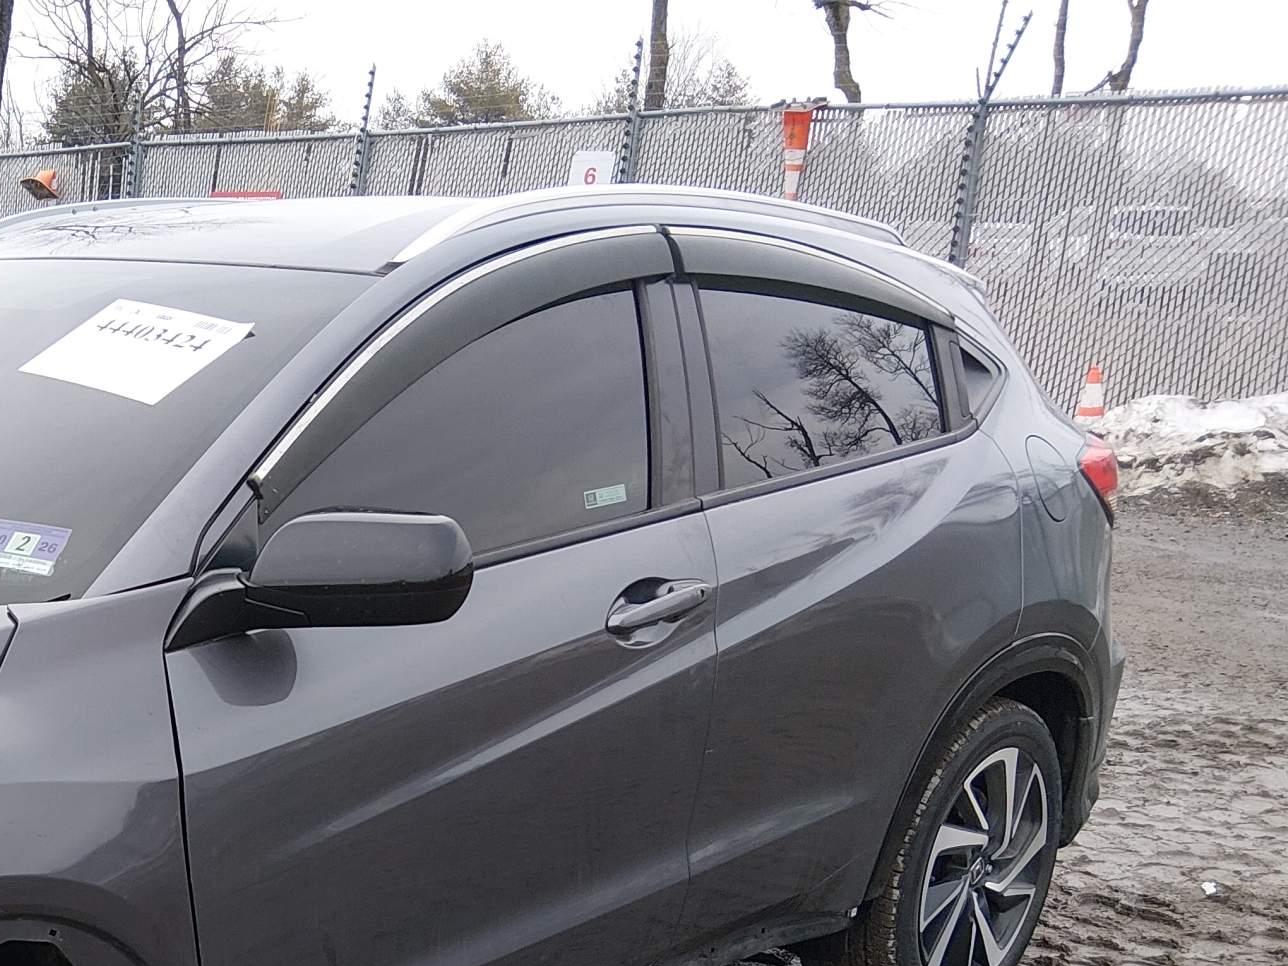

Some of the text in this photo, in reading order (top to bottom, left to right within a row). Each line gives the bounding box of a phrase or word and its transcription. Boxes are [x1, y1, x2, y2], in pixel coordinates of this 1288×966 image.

[584, 168, 597, 185] 6
[96, 319, 212, 352] 44403424
[15, 535, 31, 552] 2
[38, 541, 58, 553] 26
